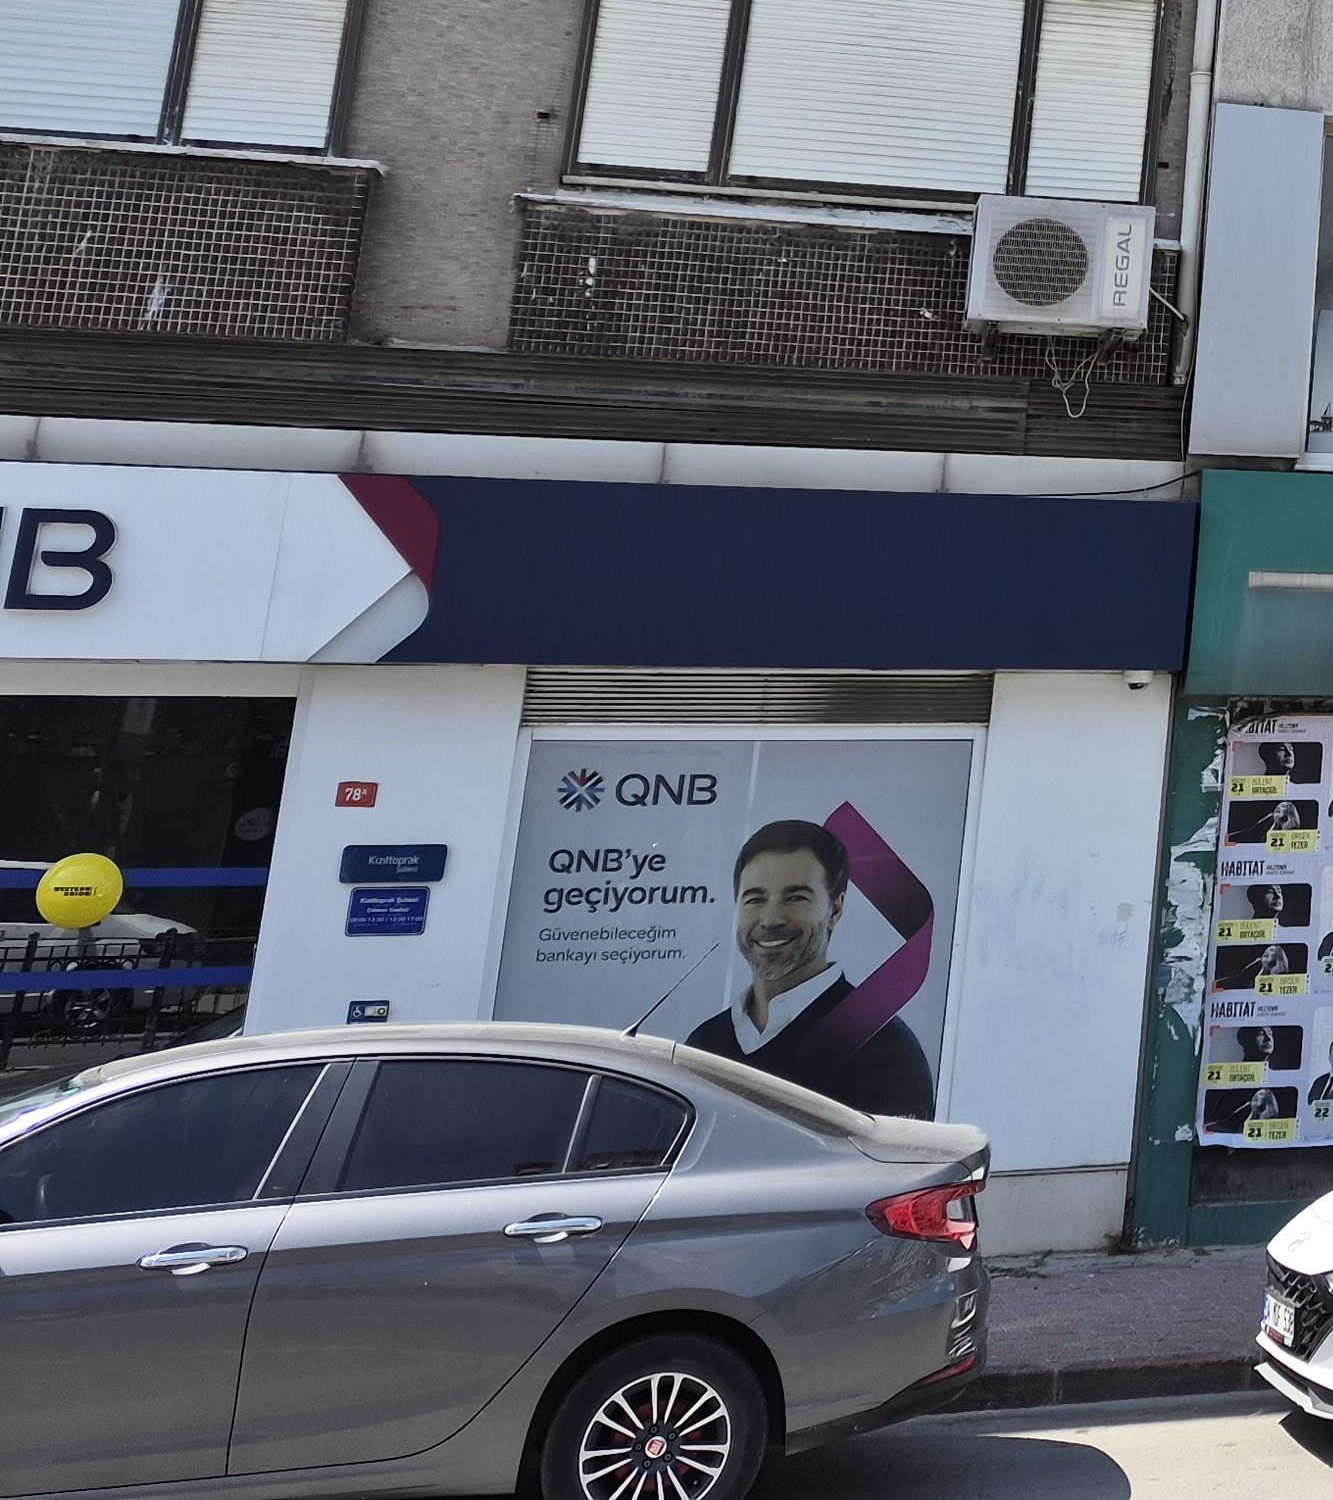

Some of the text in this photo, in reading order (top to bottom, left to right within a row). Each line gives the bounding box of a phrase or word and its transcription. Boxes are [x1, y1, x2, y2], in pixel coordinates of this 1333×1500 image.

[1113, 224, 1132, 306] REGAL
[0, 508, 116, 611] B
[615, 773, 718, 807] QNB
[1231, 783, 1244, 792] 21
[1271, 838, 1285, 847] 21
[368, 855, 420, 867] Kızıltoprak
[1221, 860, 1265, 877] HABITAT
[543, 884, 716, 913] geçiyorum.
[538, 927, 676, 943] Güvenebileceğim
[1218, 928, 1232, 937] 21
[536, 947, 686, 964] bankayı seçiyorum.
[1259, 983, 1273, 992] 21
[1210, 1001, 1256, 1018] HABITAT
[1208, 1071, 1221, 1080] 21
[1315, 1108, 1329, 1117] 22
[1248, 1128, 1262, 1137] 21
